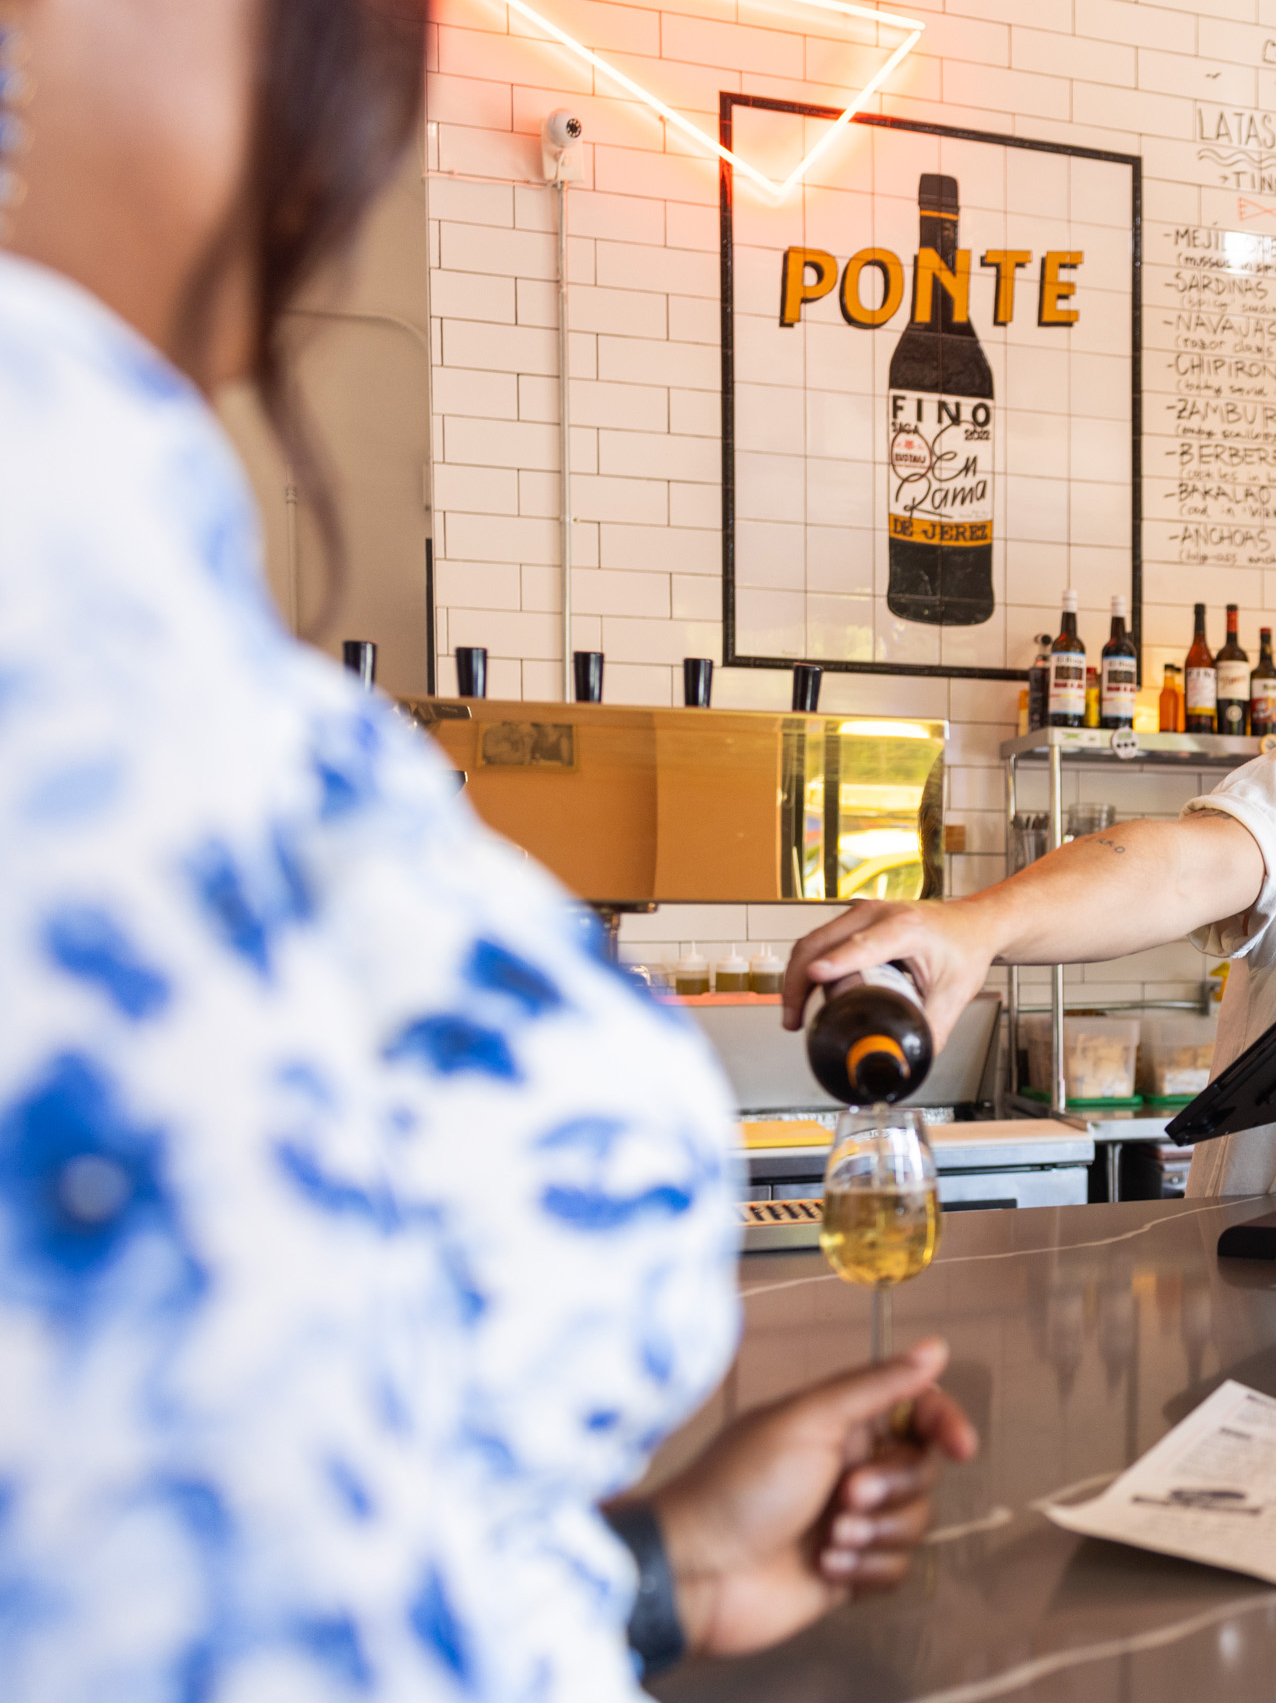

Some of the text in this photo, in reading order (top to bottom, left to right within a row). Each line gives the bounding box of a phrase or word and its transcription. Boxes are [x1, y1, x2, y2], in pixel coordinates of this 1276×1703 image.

[1198, 107, 1276, 149] LATAS
[779, 245, 1084, 328] PONTE
[892, 395, 990, 427] FINO
[895, 473, 987, 519] Rama
[893, 517, 988, 542] DE JEREZ
